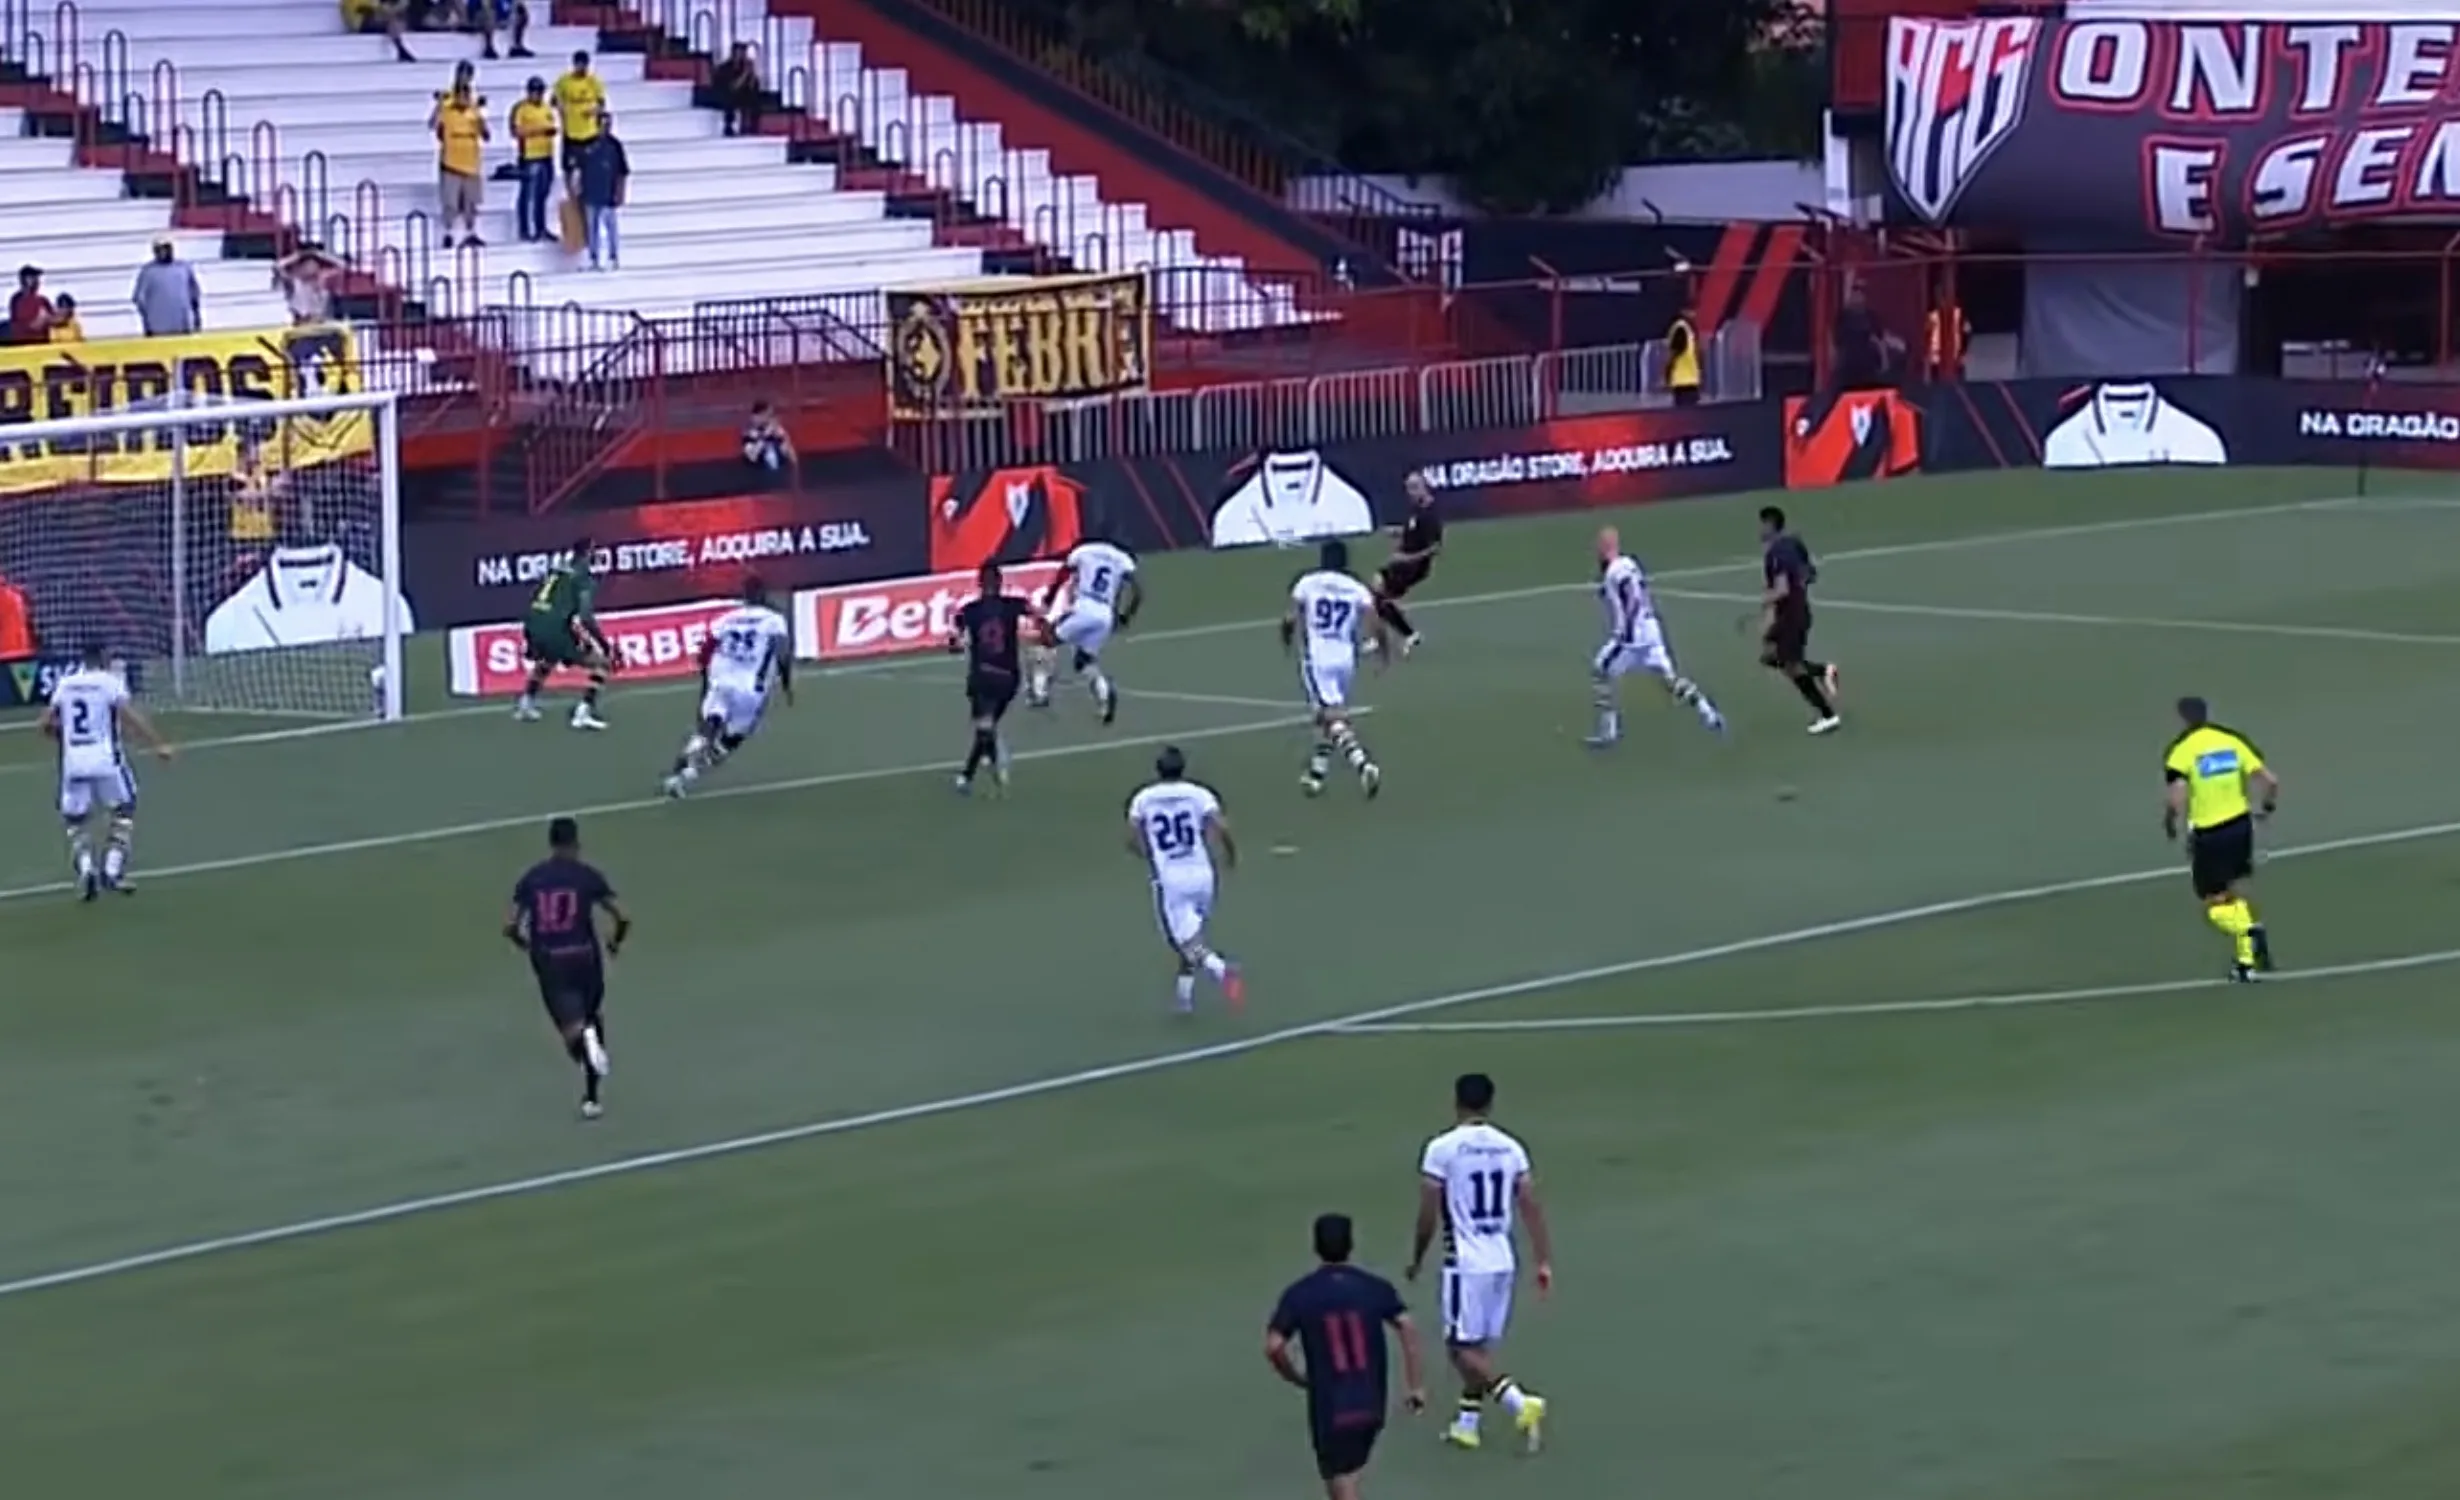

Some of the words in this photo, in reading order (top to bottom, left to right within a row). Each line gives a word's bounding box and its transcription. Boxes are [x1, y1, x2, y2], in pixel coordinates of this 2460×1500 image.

[2153, 146, 2217, 232] E
[2300, 411, 2342, 436] NA
[1422, 465, 1448, 489] NA
[1591, 444, 1668, 475] ADQUIRA
[1671, 443, 1688, 465] A
[477, 554, 513, 586] NA
[700, 527, 795, 564] ADQUIRA
[799, 525, 816, 550] A
[1091, 566, 1112, 592] 6
[1315, 598, 1352, 630] 97
[72, 699, 91, 735] 2
[1152, 810, 1195, 852] 26
[536, 888, 577, 933] 10
[1468, 1168, 1505, 1220] 11
[1323, 1311, 1368, 1371] 11
